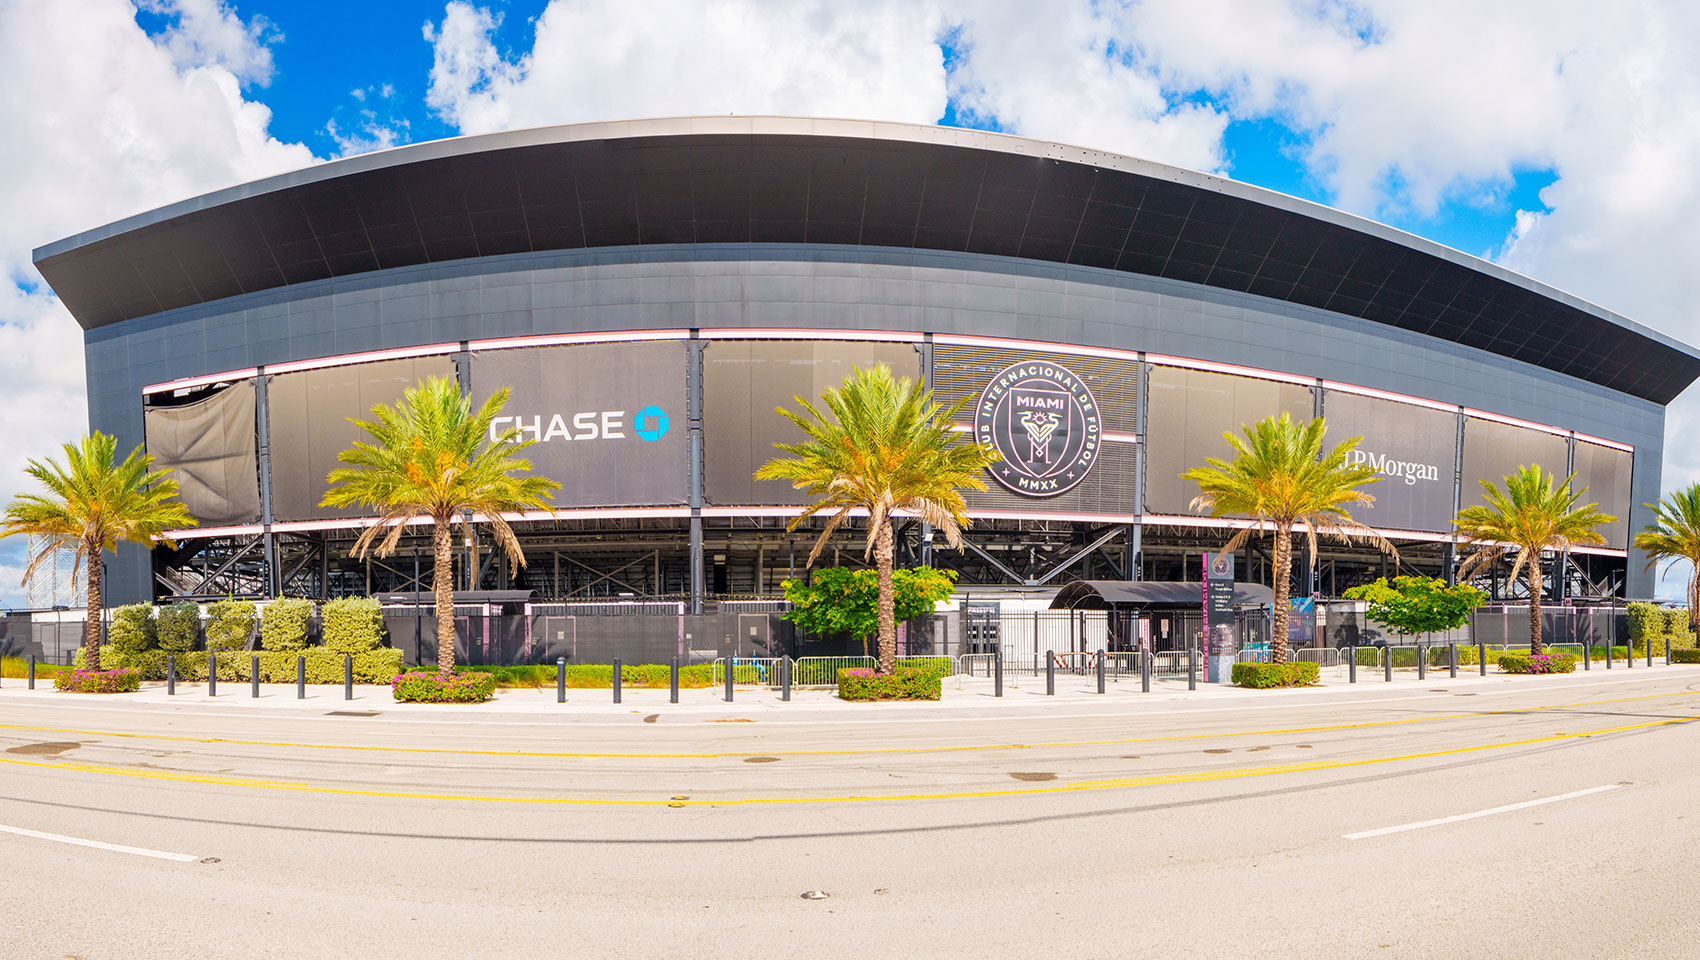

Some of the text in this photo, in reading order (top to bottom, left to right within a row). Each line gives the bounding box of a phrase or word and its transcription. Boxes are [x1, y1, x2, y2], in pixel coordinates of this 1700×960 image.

[1016, 396, 1064, 410] MIAMI
[489, 410, 626, 444] CHASE
[980, 366, 1098, 466] CLUB INTERNACIONAL DE FÚTBOL
[1018, 477, 1058, 490] MMXX
